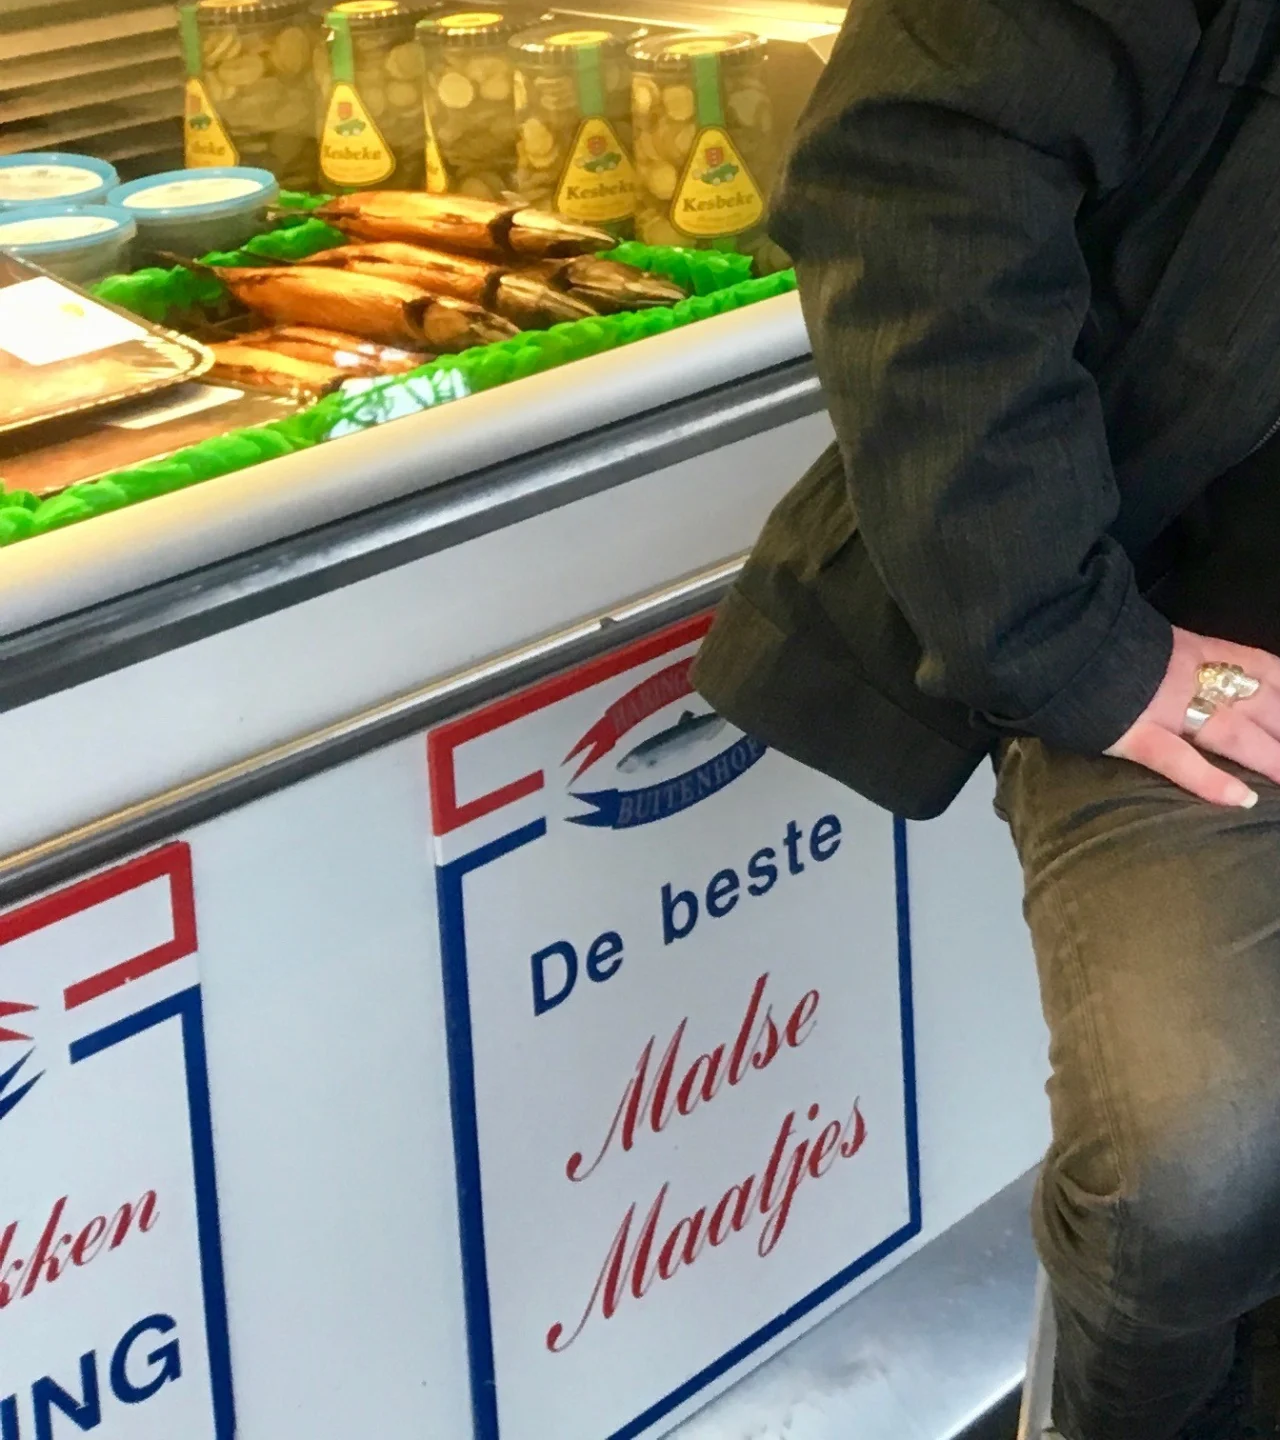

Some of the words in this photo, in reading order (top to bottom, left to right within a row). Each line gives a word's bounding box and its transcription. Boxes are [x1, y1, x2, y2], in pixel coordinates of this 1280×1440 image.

[683, 191, 754, 213] Kesbeke
[531, 931, 624, 1017] De
[661, 813, 842, 945] beste
[565, 971, 820, 1182] Malse
[546, 1095, 868, 1353] Maatjes
[0, 1313, 182, 1440] ING
